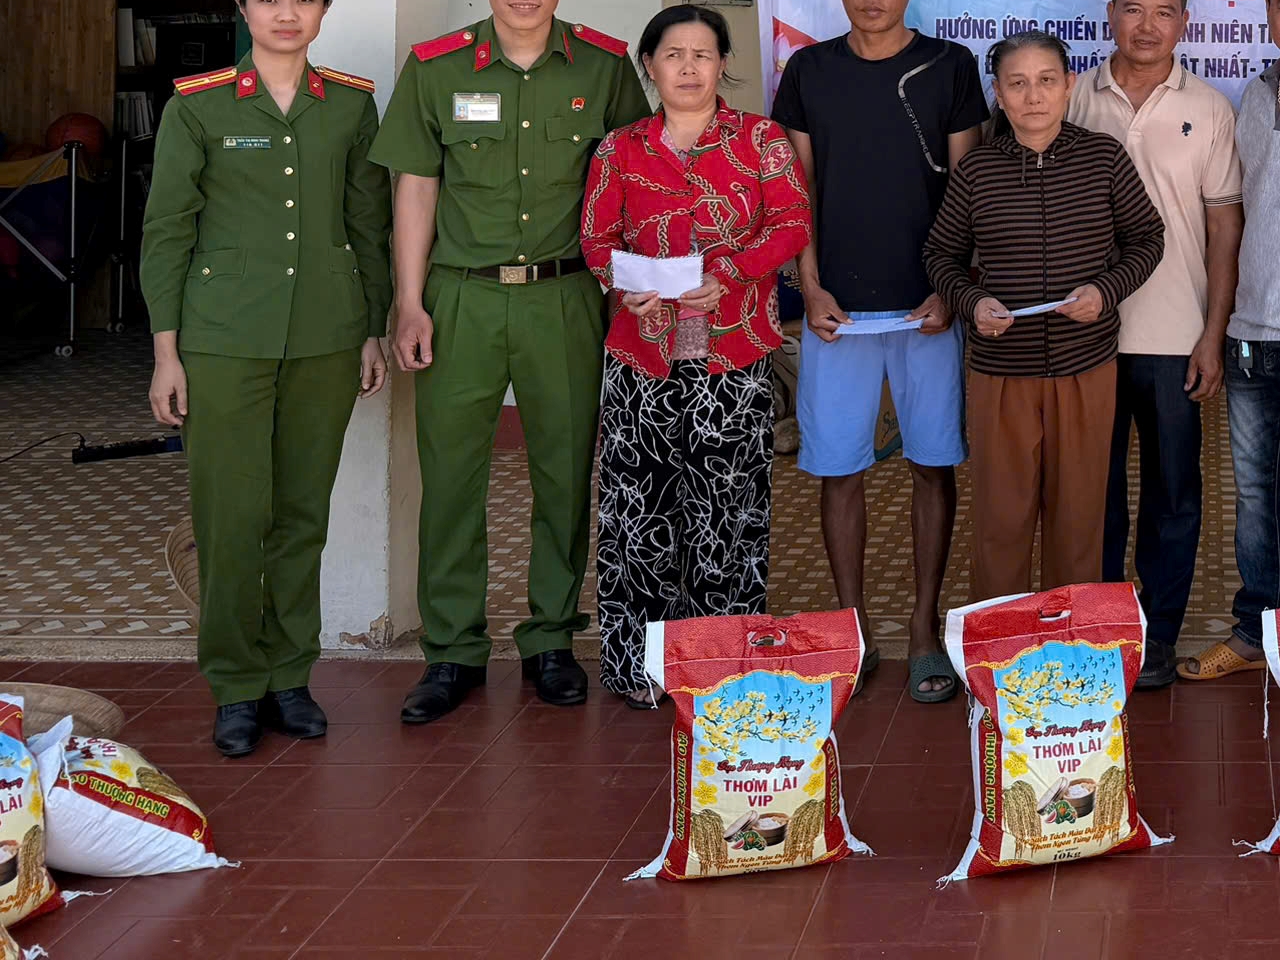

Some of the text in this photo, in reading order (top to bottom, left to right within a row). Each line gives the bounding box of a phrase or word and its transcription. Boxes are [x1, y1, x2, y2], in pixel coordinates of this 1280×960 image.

[935, 12, 997, 39] HƯỞNG
[1002, 15, 1038, 38] ỨNG
[1045, 14, 1097, 40] CHIẾN
[1211, 19, 1253, 43] NIÊN
[985, 731, 996, 787] THƯỢNG
[1032, 736, 1102, 759] THƠM LÀI
[1057, 759, 1081, 773] VIP
[723, 774, 797, 792] THƠM LÀI
[89, 777, 135, 806] THƯỢNG
[135, 795, 170, 818] HẠNG
[748, 795, 773, 807] VIP
